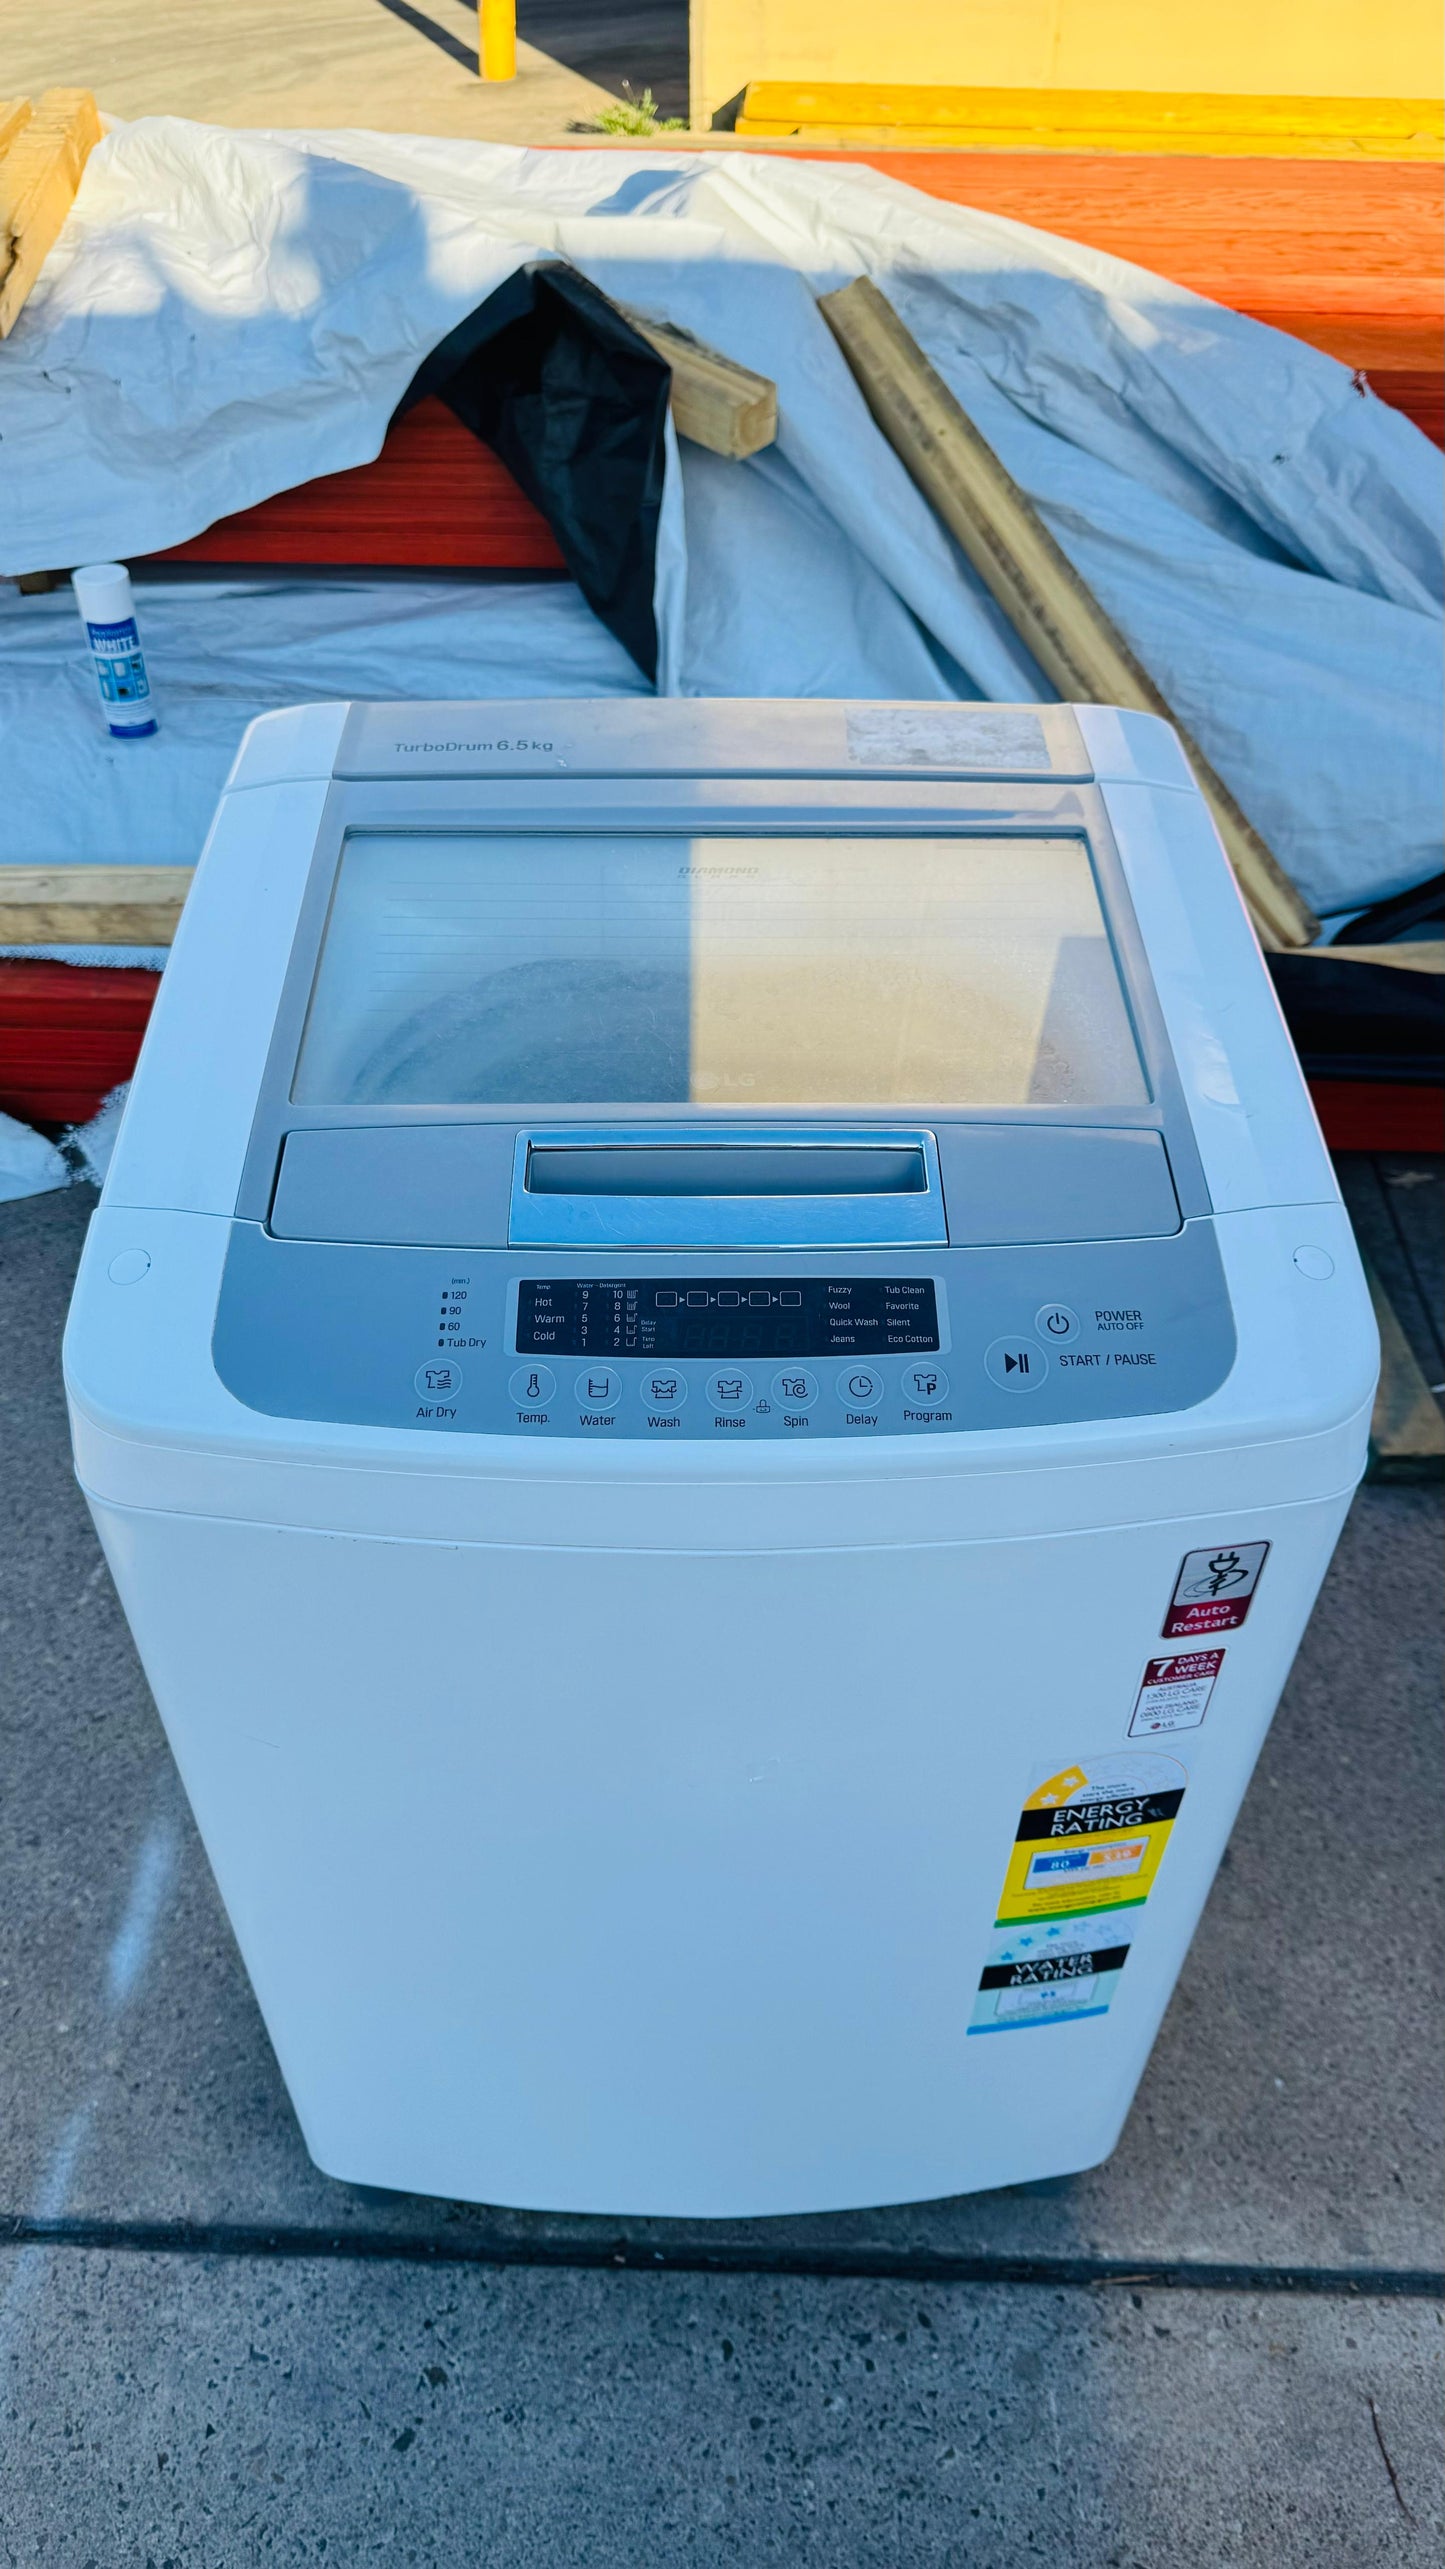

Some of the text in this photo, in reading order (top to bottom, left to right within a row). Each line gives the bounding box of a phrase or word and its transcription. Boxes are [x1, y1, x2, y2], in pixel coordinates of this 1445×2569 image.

[93, 636, 137, 652] WHITE
[394, 739, 553, 752] TurboDrum 6.5 kg
[723, 1072, 756, 1087] LG
[582, 1290, 589, 1299] 9
[613, 1290, 623, 1299] 10
[828, 1285, 852, 1295] Fuzzy
[884, 1286, 925, 1294] Tub Clean
[451, 1291, 467, 1300] 120
[534, 1297, 553, 1307] Hot
[582, 1302, 589, 1311] 7
[614, 1302, 621, 1311] 8
[828, 1301, 851, 1310] Wool
[885, 1302, 920, 1310] Favorite
[449, 1306, 462, 1315] 90
[534, 1314, 565, 1323] Warm
[581, 1313, 588, 1323] 5
[614, 1313, 621, 1323] 6
[1095, 1310, 1142, 1322] POWER
[448, 1322, 461, 1331] 60
[829, 1318, 879, 1327] Quick Wash
[886, 1318, 911, 1326] Silent
[1097, 1322, 1145, 1331] AUTO OFF
[581, 1325, 588, 1335] 3
[613, 1325, 621, 1335] 4
[533, 1331, 556, 1341] Cold
[830, 1335, 856, 1343] Jeans
[887, 1335, 933, 1343] Eco Cotton
[447, 1338, 487, 1349] Tub Dry
[581, 1338, 586, 1347] 1
[613, 1338, 620, 1347] 2
[1059, 1354, 1101, 1366] START
[1114, 1353, 1157, 1365] PAUSE
[416, 1406, 457, 1419] Air Dry
[903, 1410, 953, 1424] Program
[516, 1412, 551, 1425] Temp.
[579, 1415, 616, 1426] Water
[647, 1416, 681, 1427] Wash
[714, 1417, 746, 1428] Rinse
[783, 1415, 809, 1428] Spin
[846, 1413, 878, 1427] Delay
[1186, 1605, 1231, 1619] Auto
[1171, 1615, 1239, 1633] Restart
[1177, 1652, 1219, 1665] DAYS A
[1153, 1659, 1175, 1677] 7
[1174, 1660, 1217, 1675] WEEK
[1053, 1798, 1150, 1823] ENERGY
[1050, 1812, 1144, 1836] RATING
[1015, 1953, 1093, 1974] WATER
[1009, 1966, 1093, 1986] RATING
